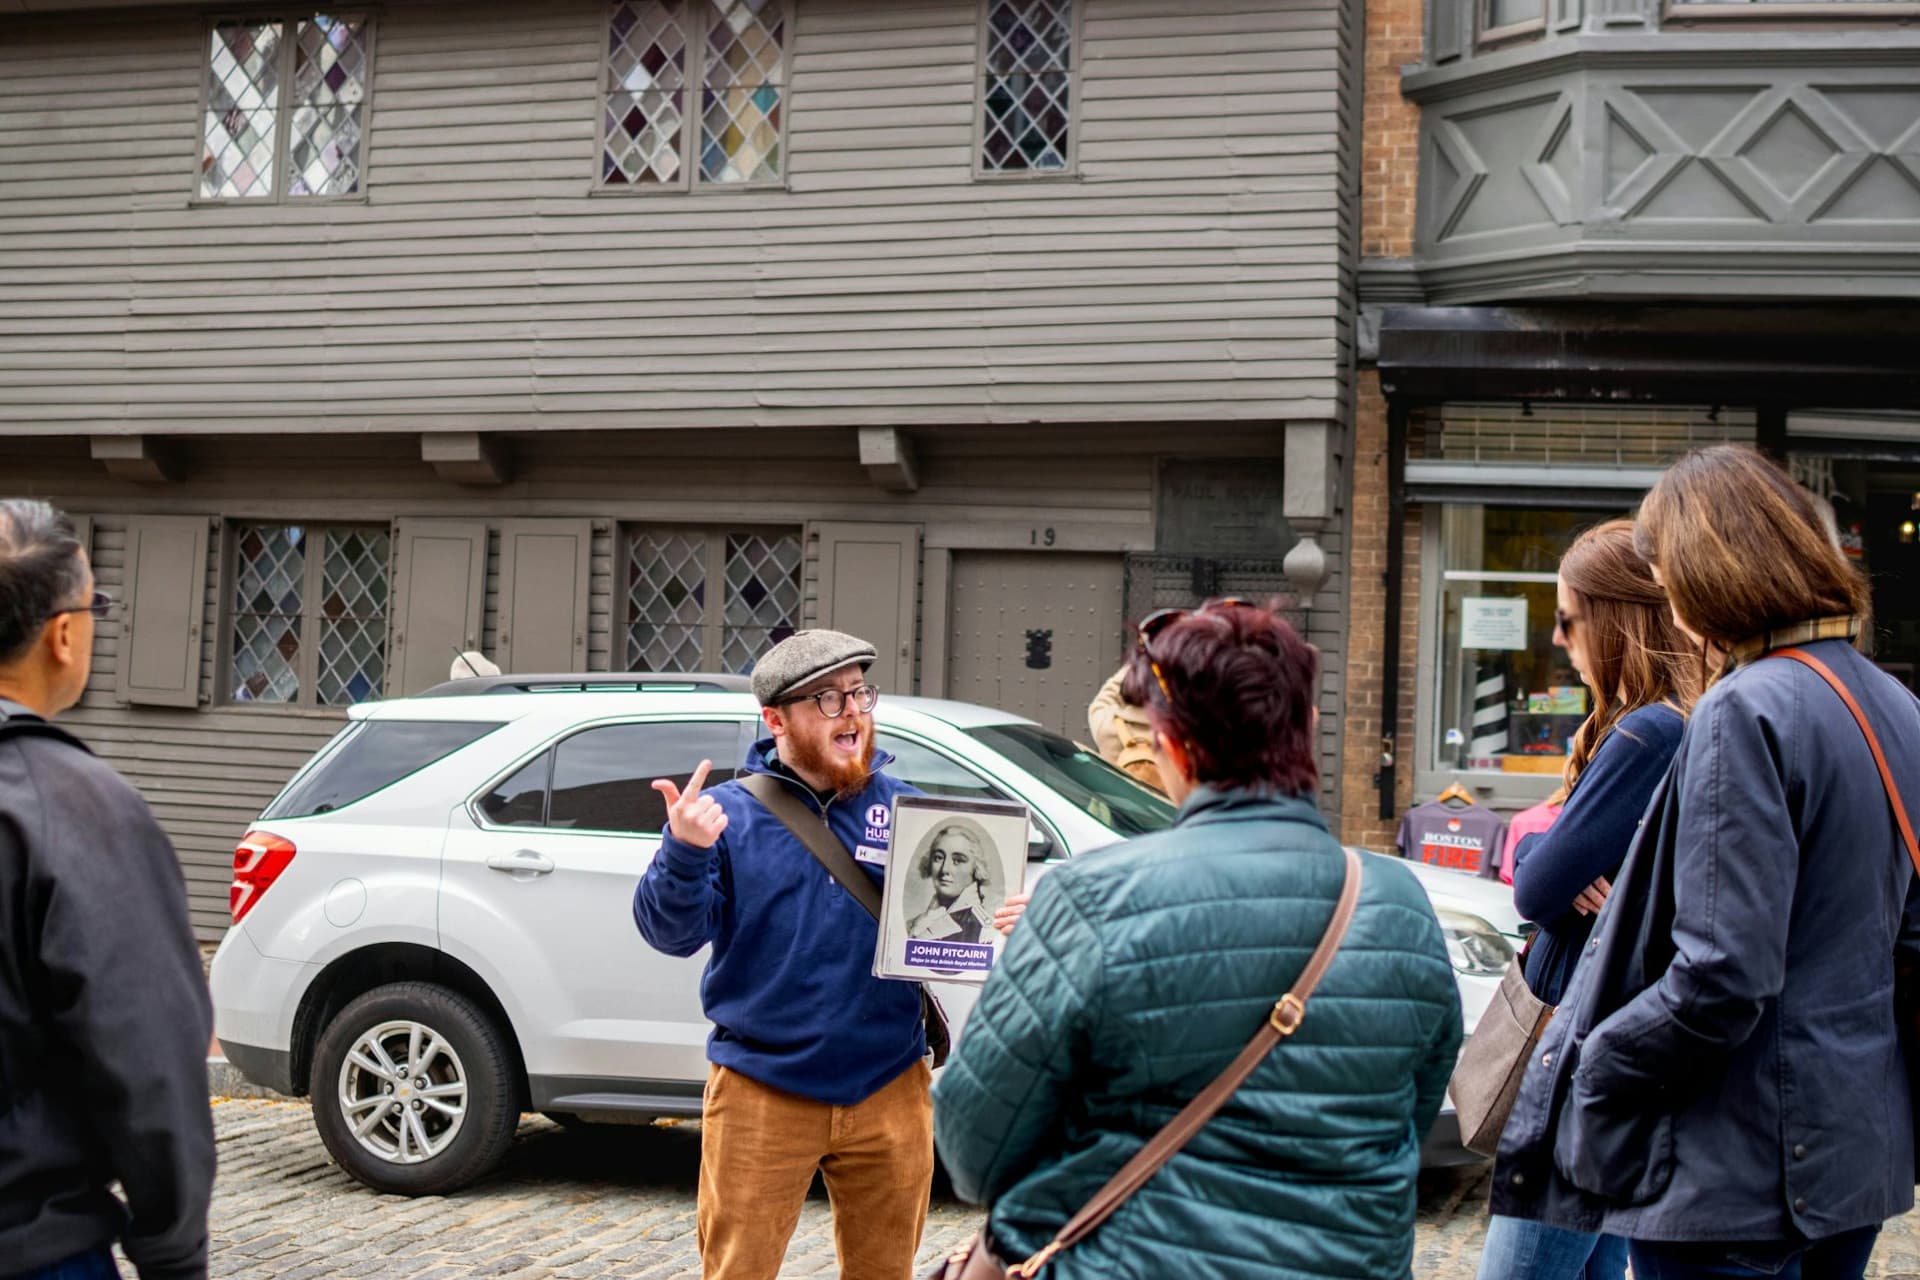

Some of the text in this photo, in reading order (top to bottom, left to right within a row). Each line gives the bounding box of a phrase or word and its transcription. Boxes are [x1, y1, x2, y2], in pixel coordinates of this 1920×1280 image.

[1030, 527, 1056, 546] 19
[872, 808, 885, 824] H
[865, 827, 889, 838] HUB
[1424, 833, 1482, 847] BOSTON
[1423, 844, 1480, 870] FIRE
[912, 946, 987, 959] JOHN PITCAIRN
